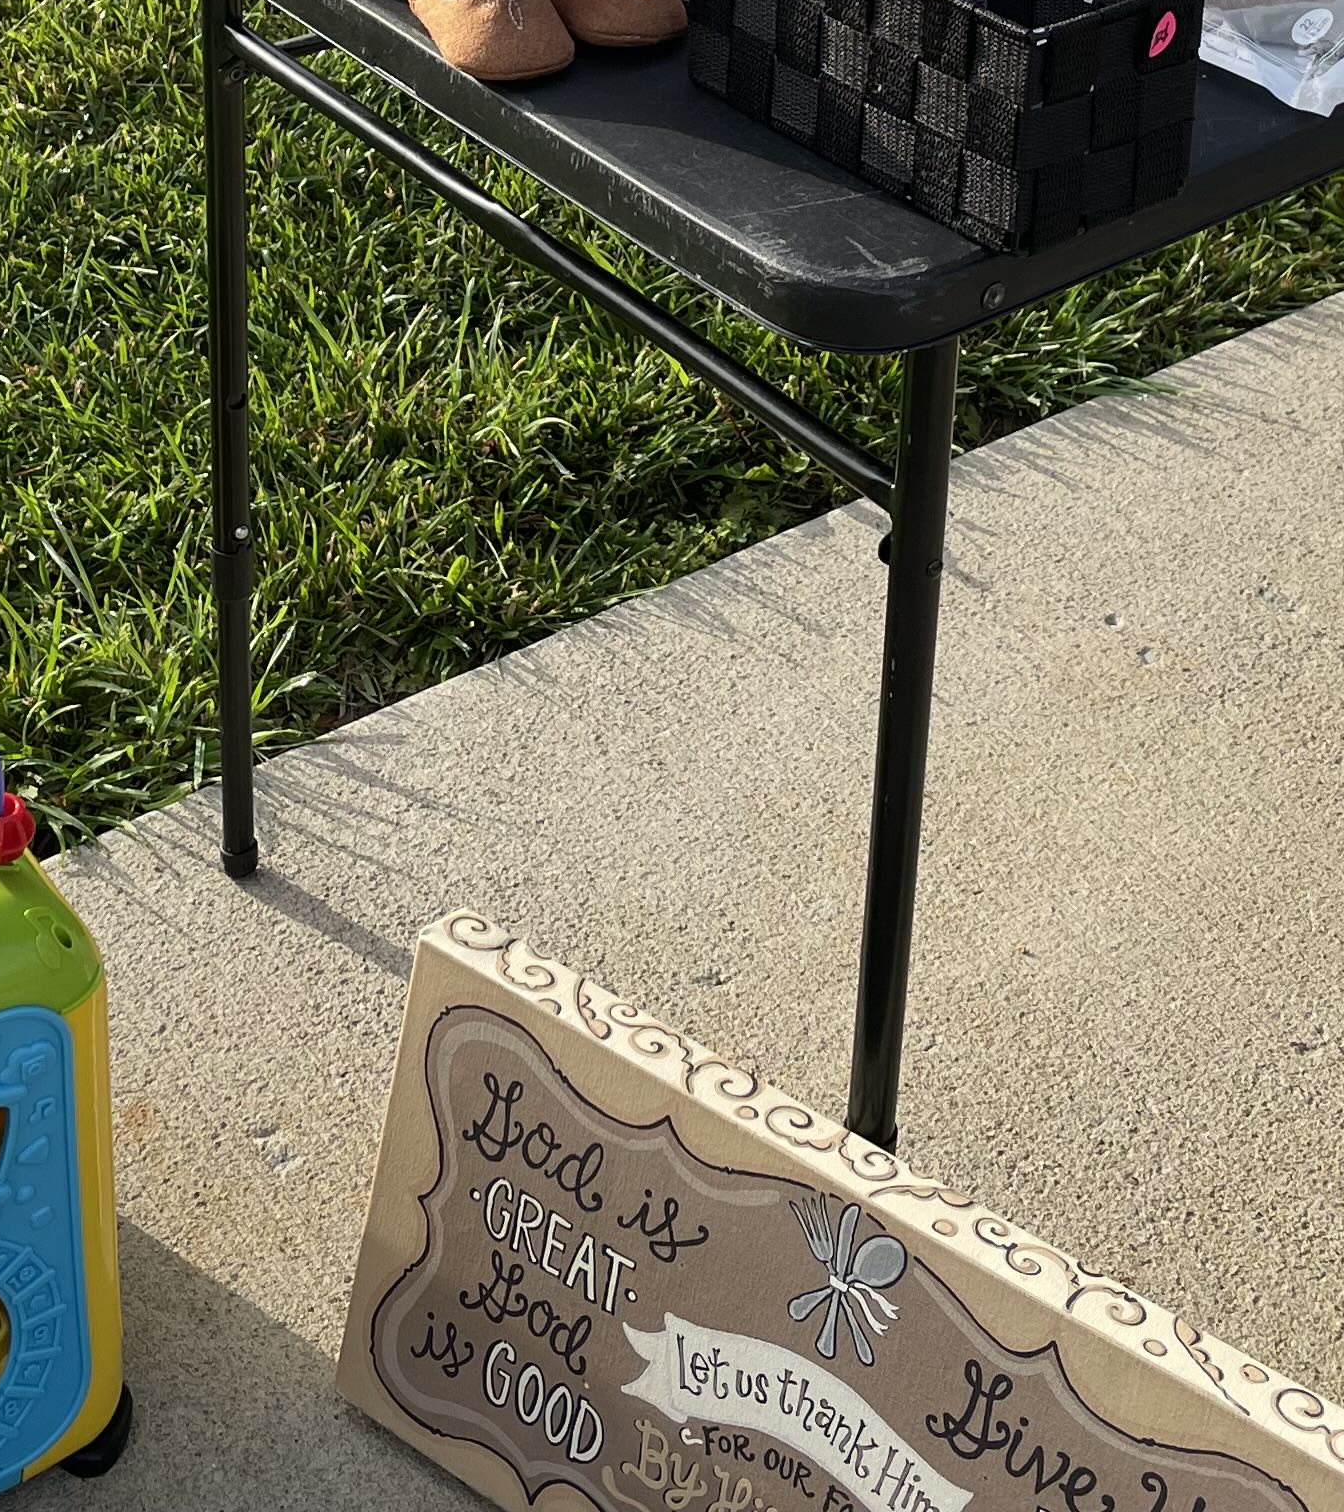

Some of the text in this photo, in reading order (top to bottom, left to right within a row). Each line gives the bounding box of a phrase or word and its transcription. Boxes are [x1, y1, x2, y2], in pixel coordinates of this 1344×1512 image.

[463, 1073, 709, 1262] God is
[460, 1251, 593, 1375] God
[485, 1178, 636, 1315] GREAT
[411, 1312, 605, 1464] is GOOD
[675, 1334, 729, 1400] Let
[735, 1369, 770, 1405] us
[777, 1369, 878, 1478] thank
[925, 1358, 1116, 1512] Give
[620, 1419, 709, 1511] By
[702, 1425, 755, 1462] FOR
[764, 1447, 815, 1498] OUR
